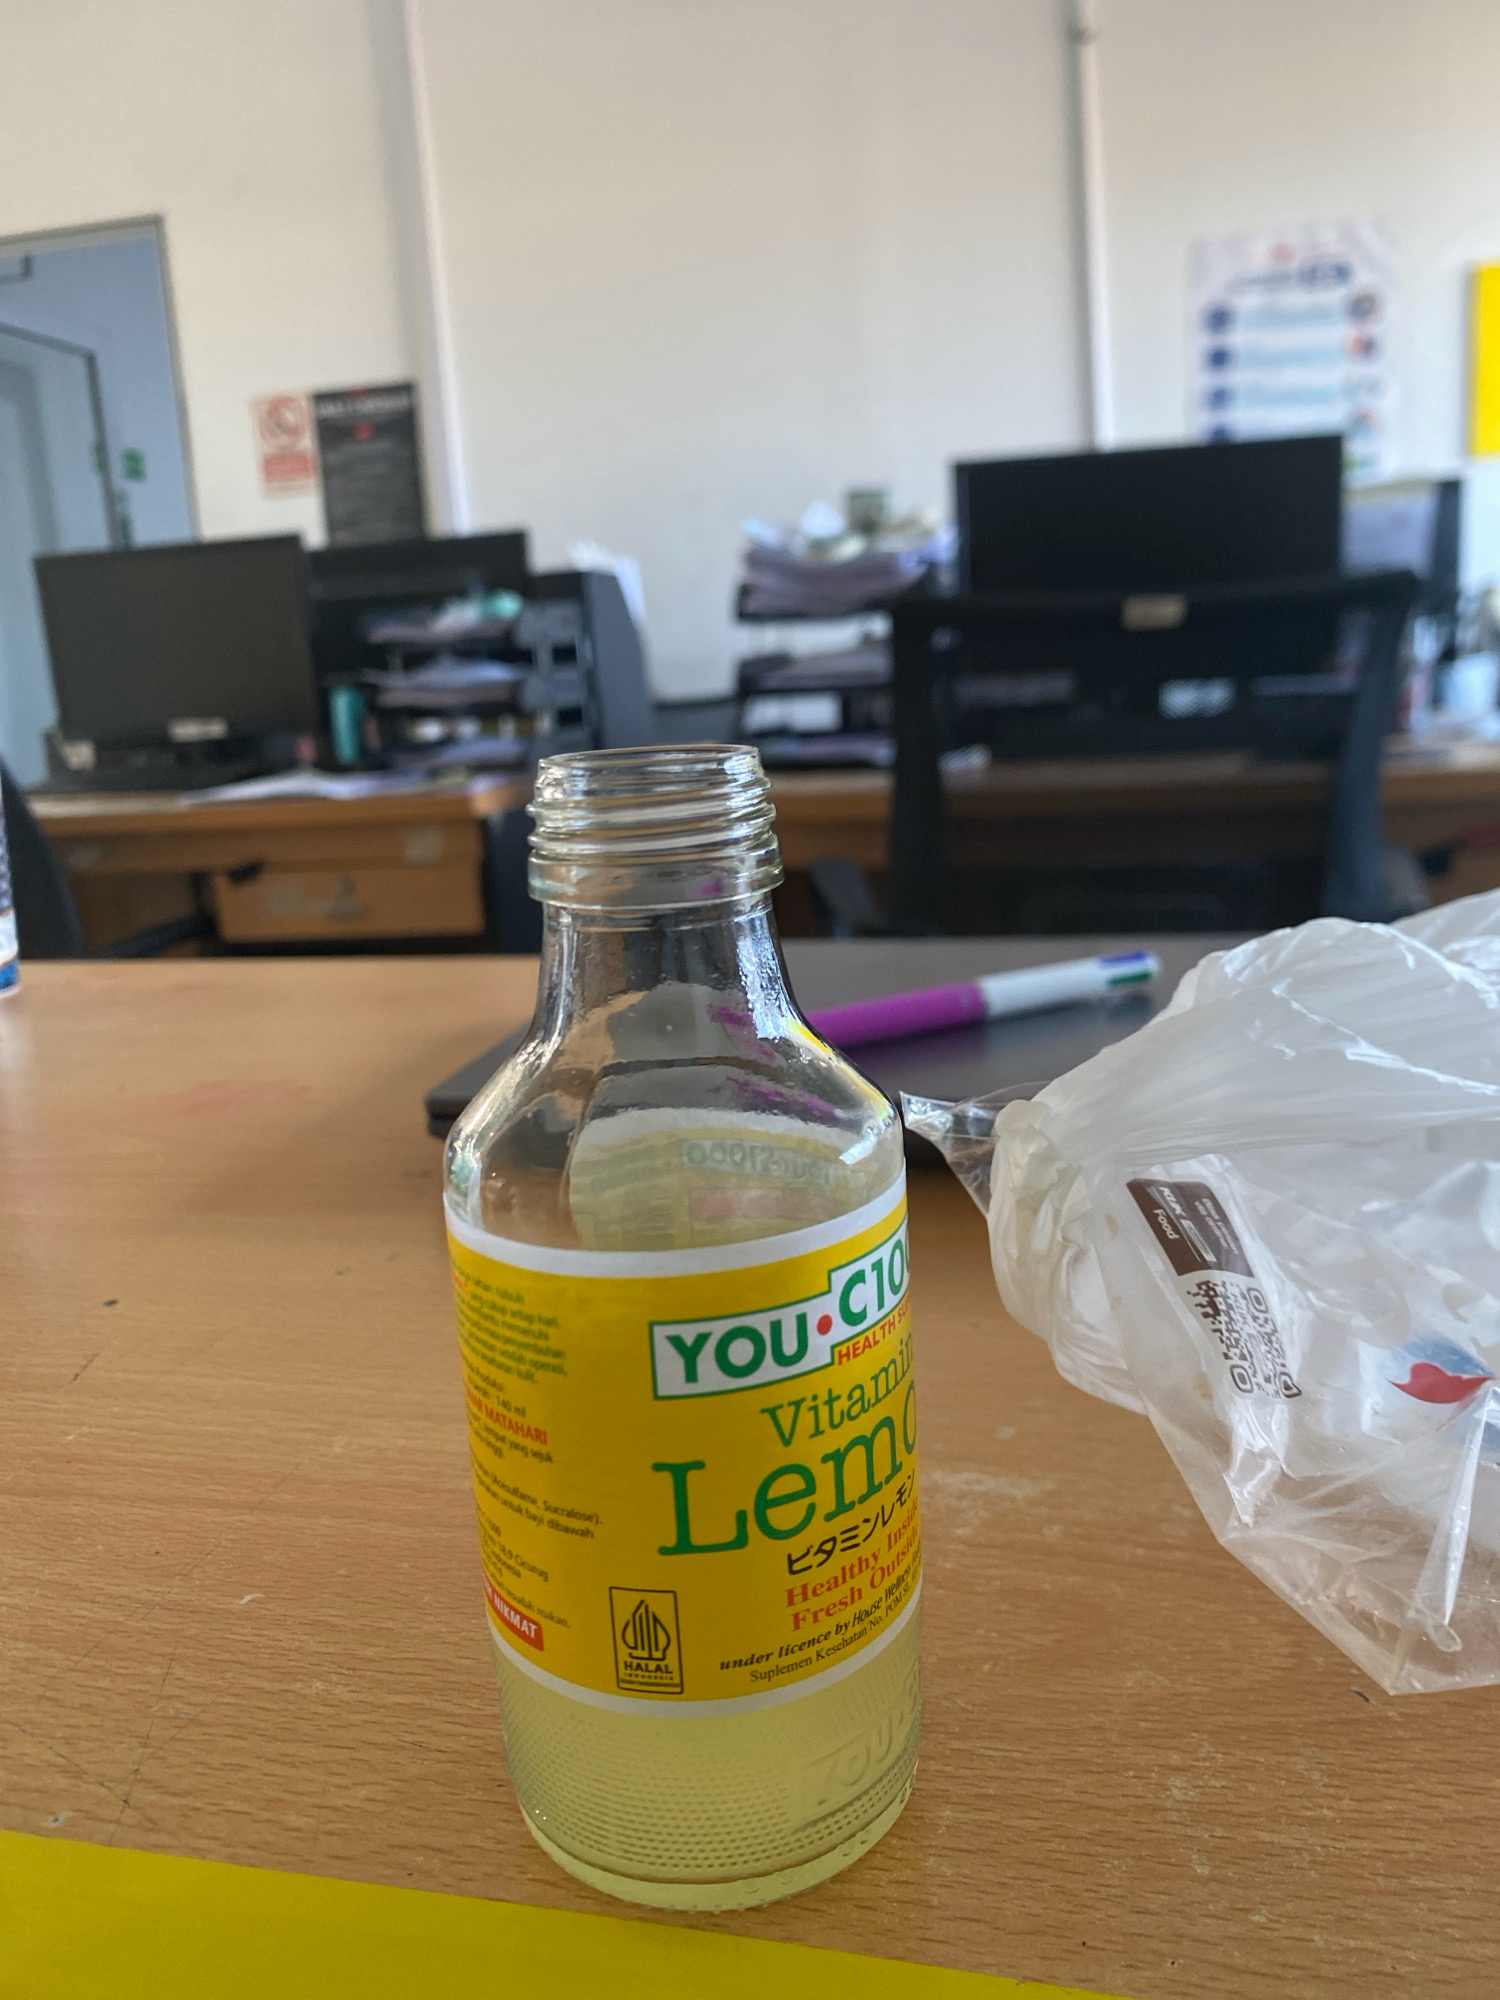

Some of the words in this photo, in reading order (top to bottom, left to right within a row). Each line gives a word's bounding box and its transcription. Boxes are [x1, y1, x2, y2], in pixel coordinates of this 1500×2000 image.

[1152, 1208, 1180, 1240] Food
[837, 1314, 896, 1366] HEALTH
[760, 1332, 914, 1447] Vitamin
[484, 1403, 549, 1447] MATAHARI
[546, 1518, 595, 1540] dibawah
[787, 1467, 914, 1575] ビタミンレモン
[785, 1546, 880, 1608] Healthy
[493, 1592, 540, 1639] NIKMAT
[720, 1651, 775, 1671] under
[778, 1629, 833, 1660] licence
[834, 1619, 851, 1637] by
[852, 1597, 883, 1626] House
[791, 1585, 864, 1633] Fresh
[623, 1660, 674, 1675] HALAL
[750, 1655, 813, 1683] Suplemen
[815, 1627, 868, 1663] Kesehatan
